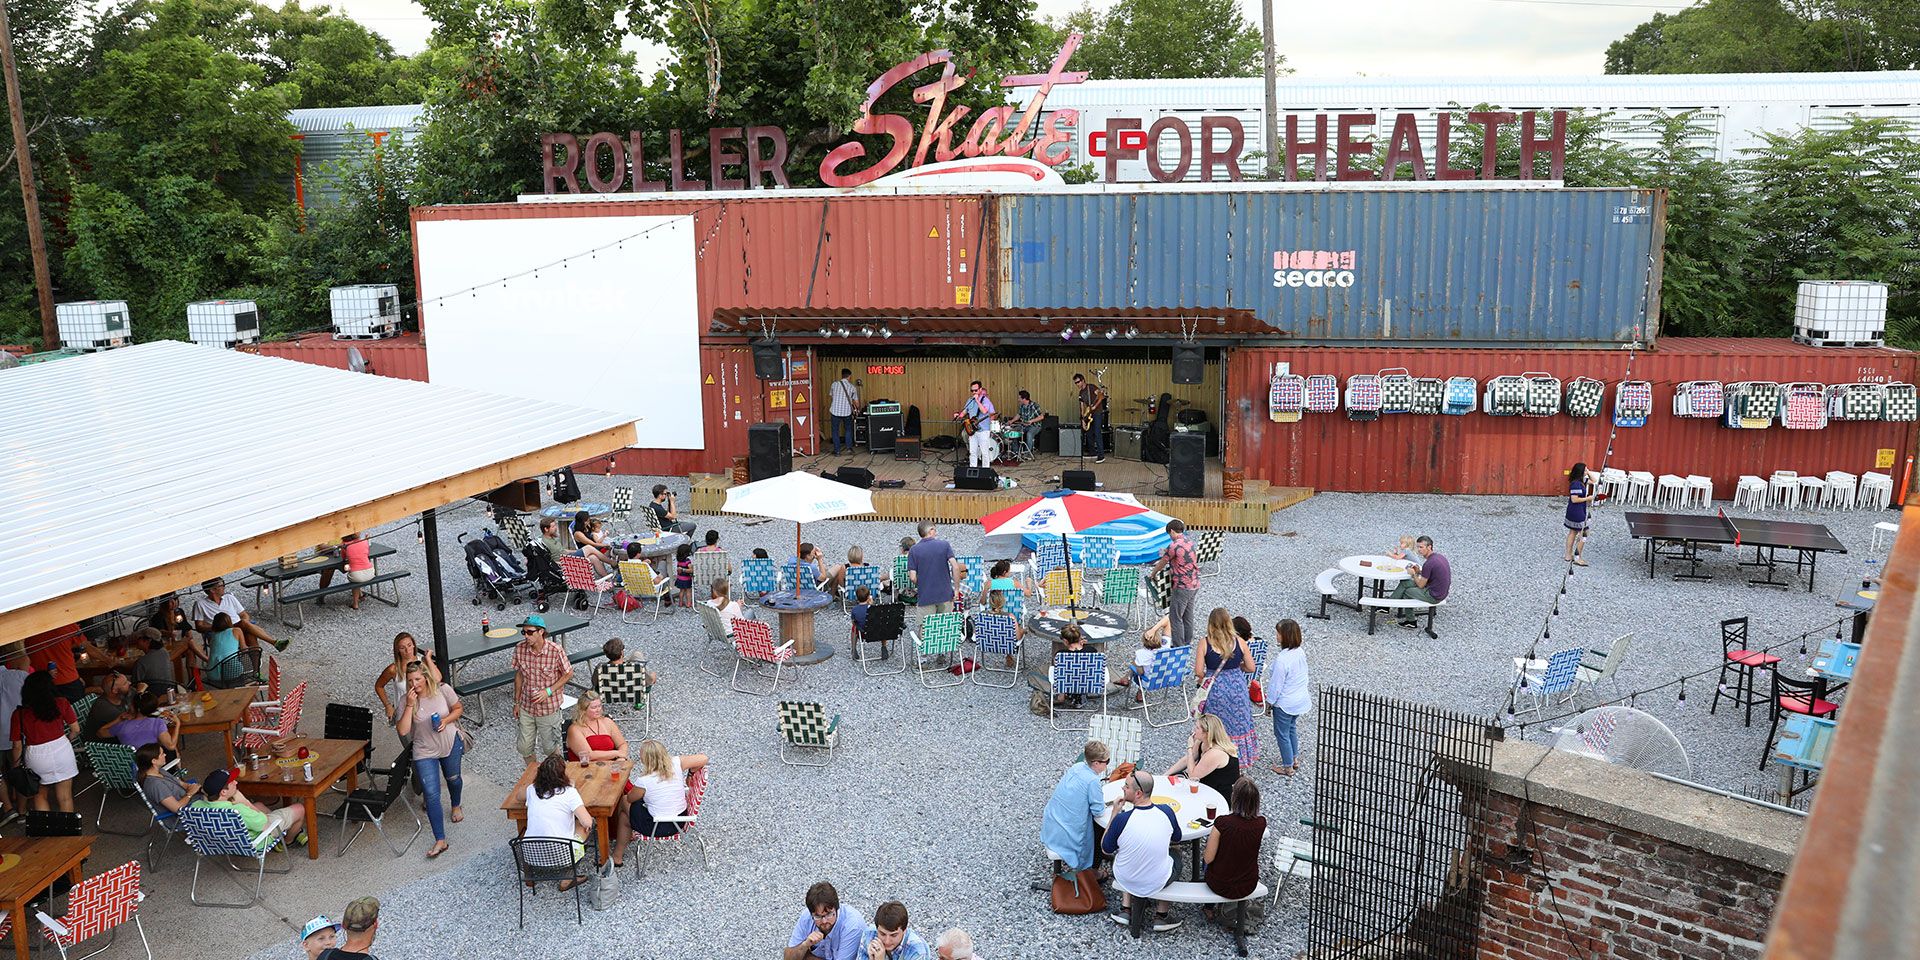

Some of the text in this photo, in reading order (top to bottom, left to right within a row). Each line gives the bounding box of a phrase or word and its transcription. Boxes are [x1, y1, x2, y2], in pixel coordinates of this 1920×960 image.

[542, 33, 1567, 194] ROLLER Skate FOR HEALTH
[1273, 270, 1355, 288] seaco
[867, 365, 904, 374] LIVE MUSIC
